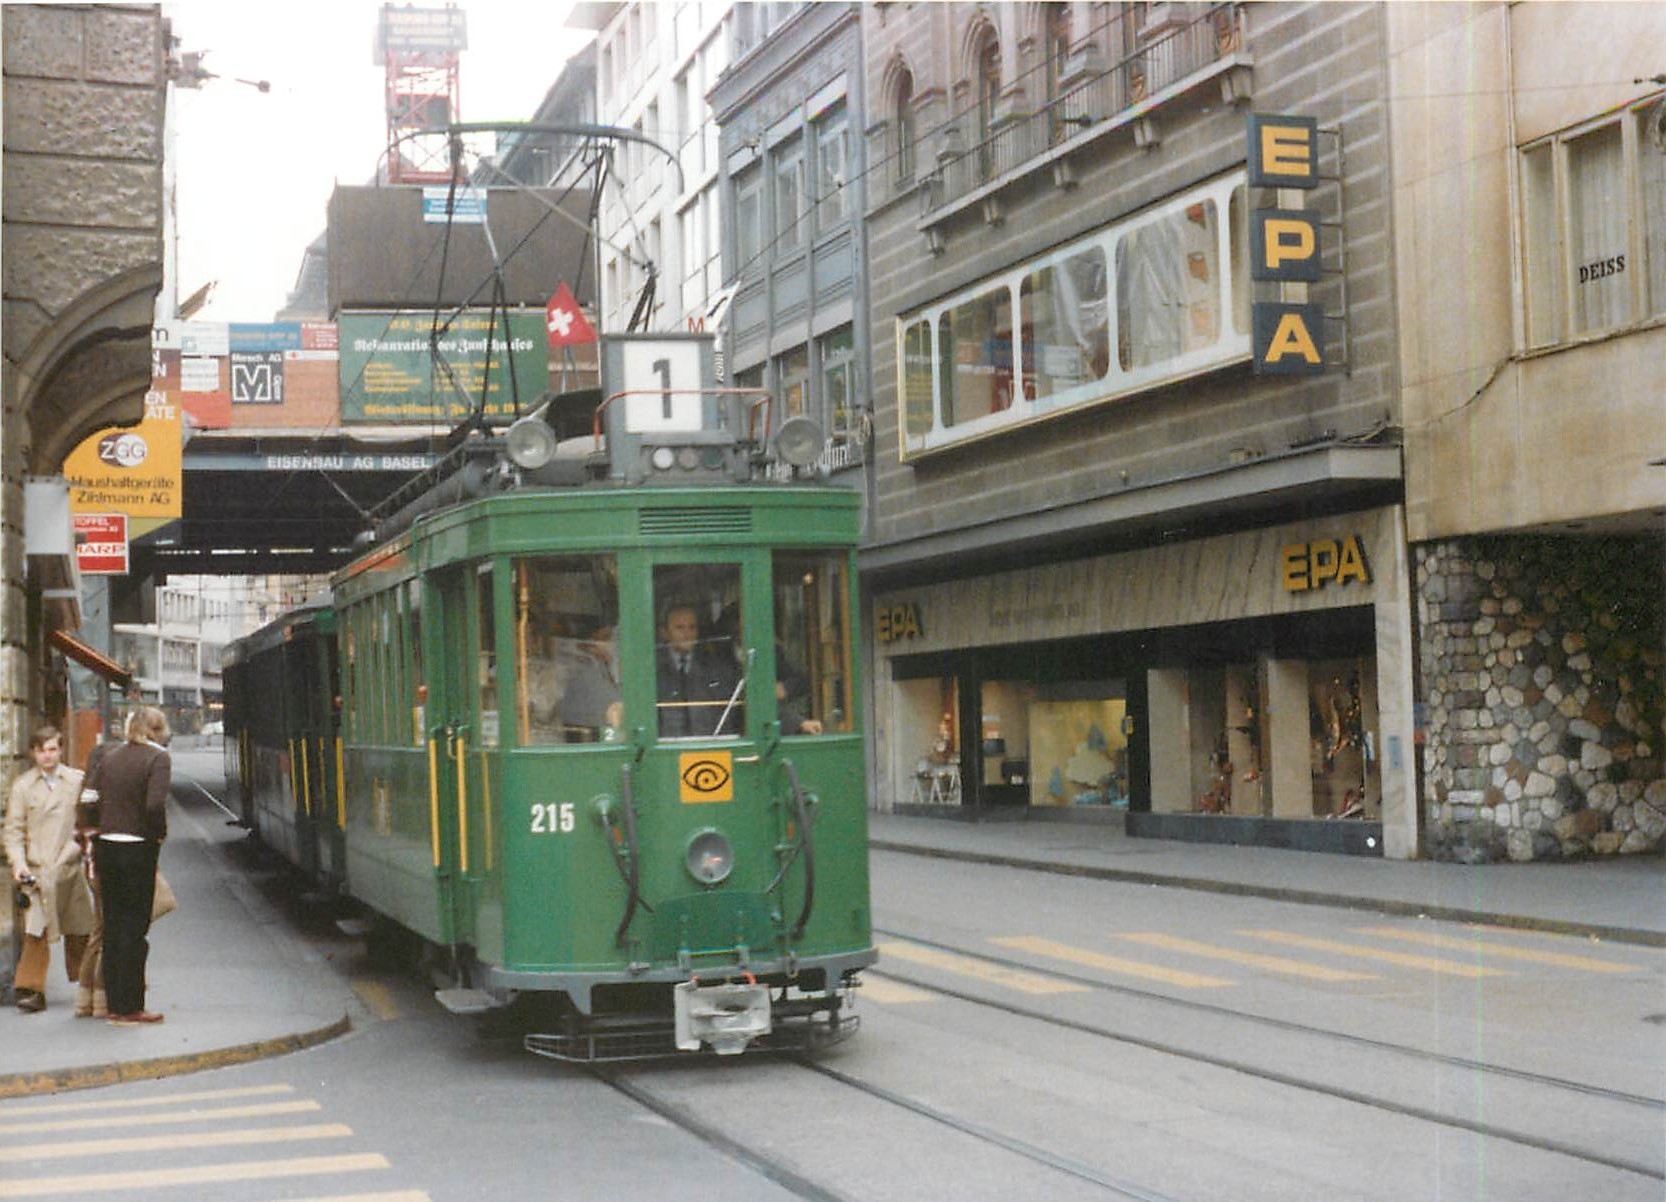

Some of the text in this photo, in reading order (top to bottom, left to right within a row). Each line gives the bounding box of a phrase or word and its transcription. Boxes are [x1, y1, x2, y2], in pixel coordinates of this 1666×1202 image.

[1262, 125, 1322, 364] EPA
[1579, 255, 1627, 284] DEISS
[652, 359, 672, 420] 1
[267, 456, 431, 469] EISENBAU AG BASEL
[150, 491, 171, 505] AG
[1282, 536, 1370, 592] EPA
[876, 604, 921, 641] EPA
[530, 803, 575, 833] 215
